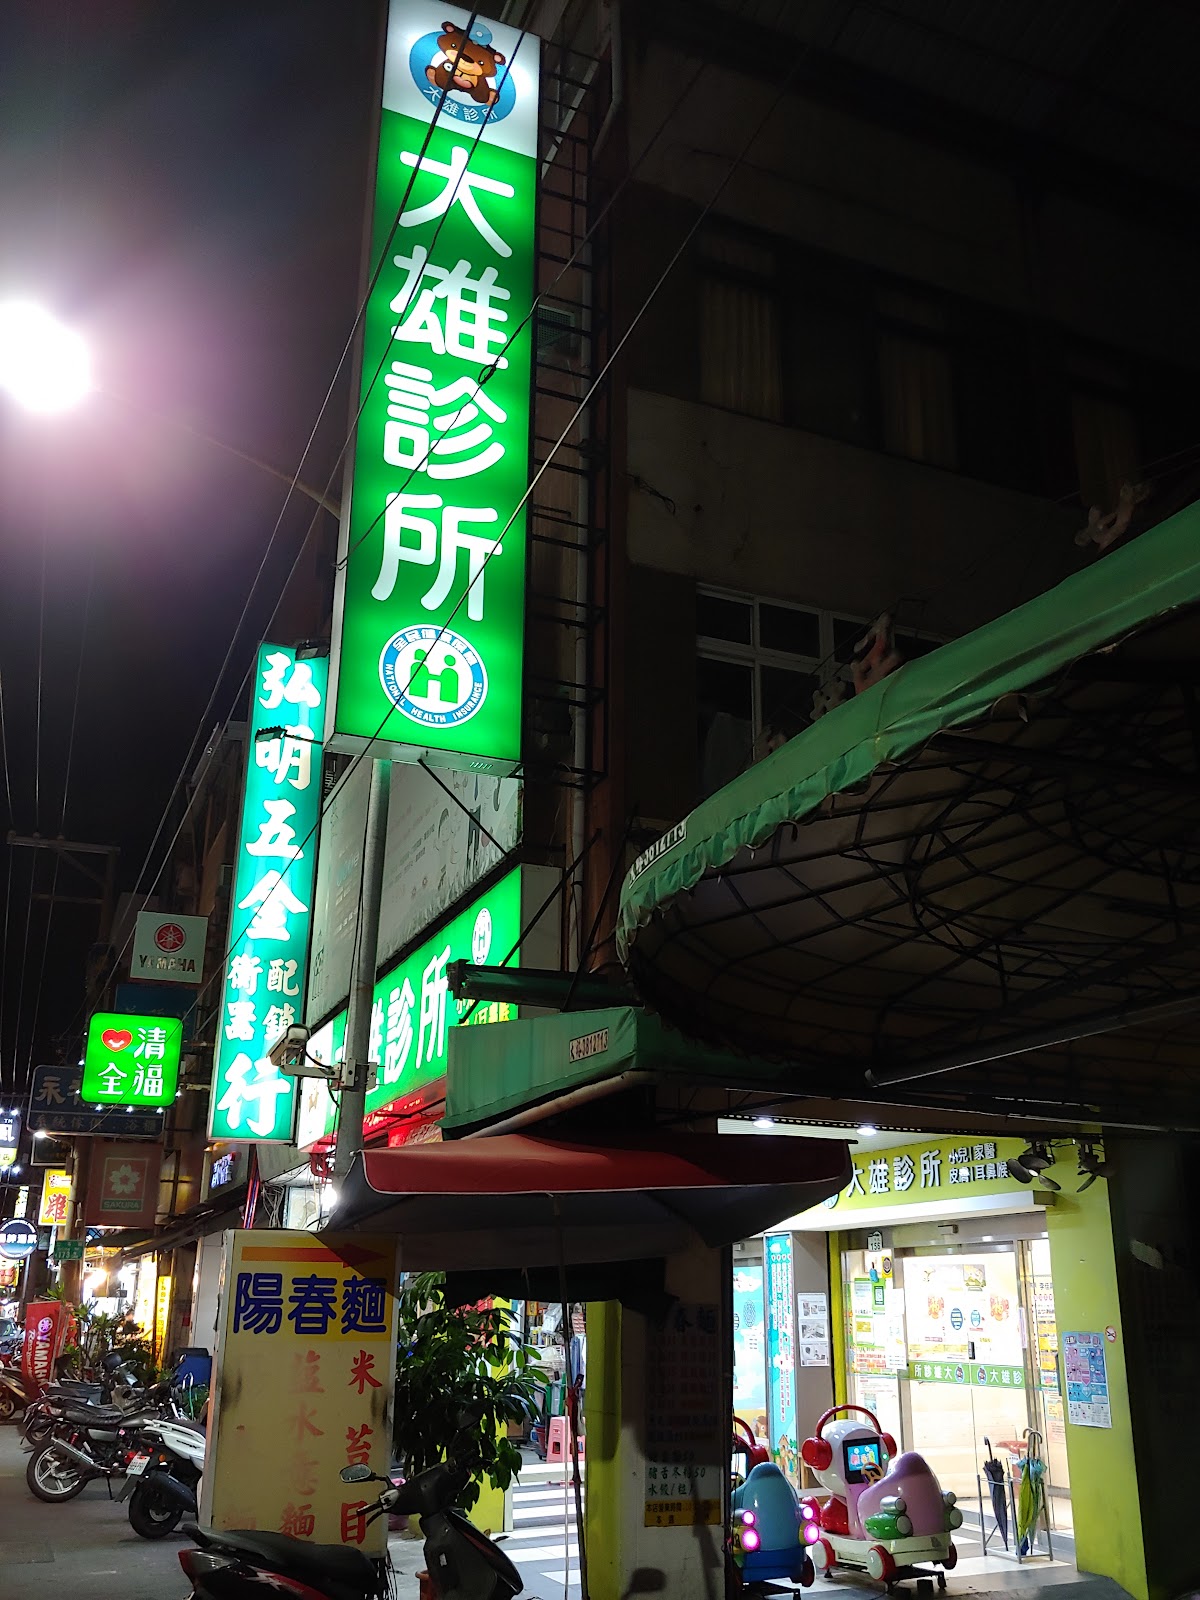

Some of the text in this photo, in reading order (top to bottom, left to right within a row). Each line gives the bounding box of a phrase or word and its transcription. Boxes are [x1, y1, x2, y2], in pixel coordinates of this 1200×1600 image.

[423, 86, 498, 121] 大雄診所
[371, 146, 515, 621] 大雄診所
[385, 664, 482, 723] NATIONAL HEALTH INSURANCE
[139, 954, 195, 972] YAMAHA
[846, 1149, 942, 1198] 大雄診所
[233, 1273, 387, 1335] 陽春麵
[34, 1331, 55, 1387] YAMAHA
[339, 1350, 383, 1545] 米苔目
